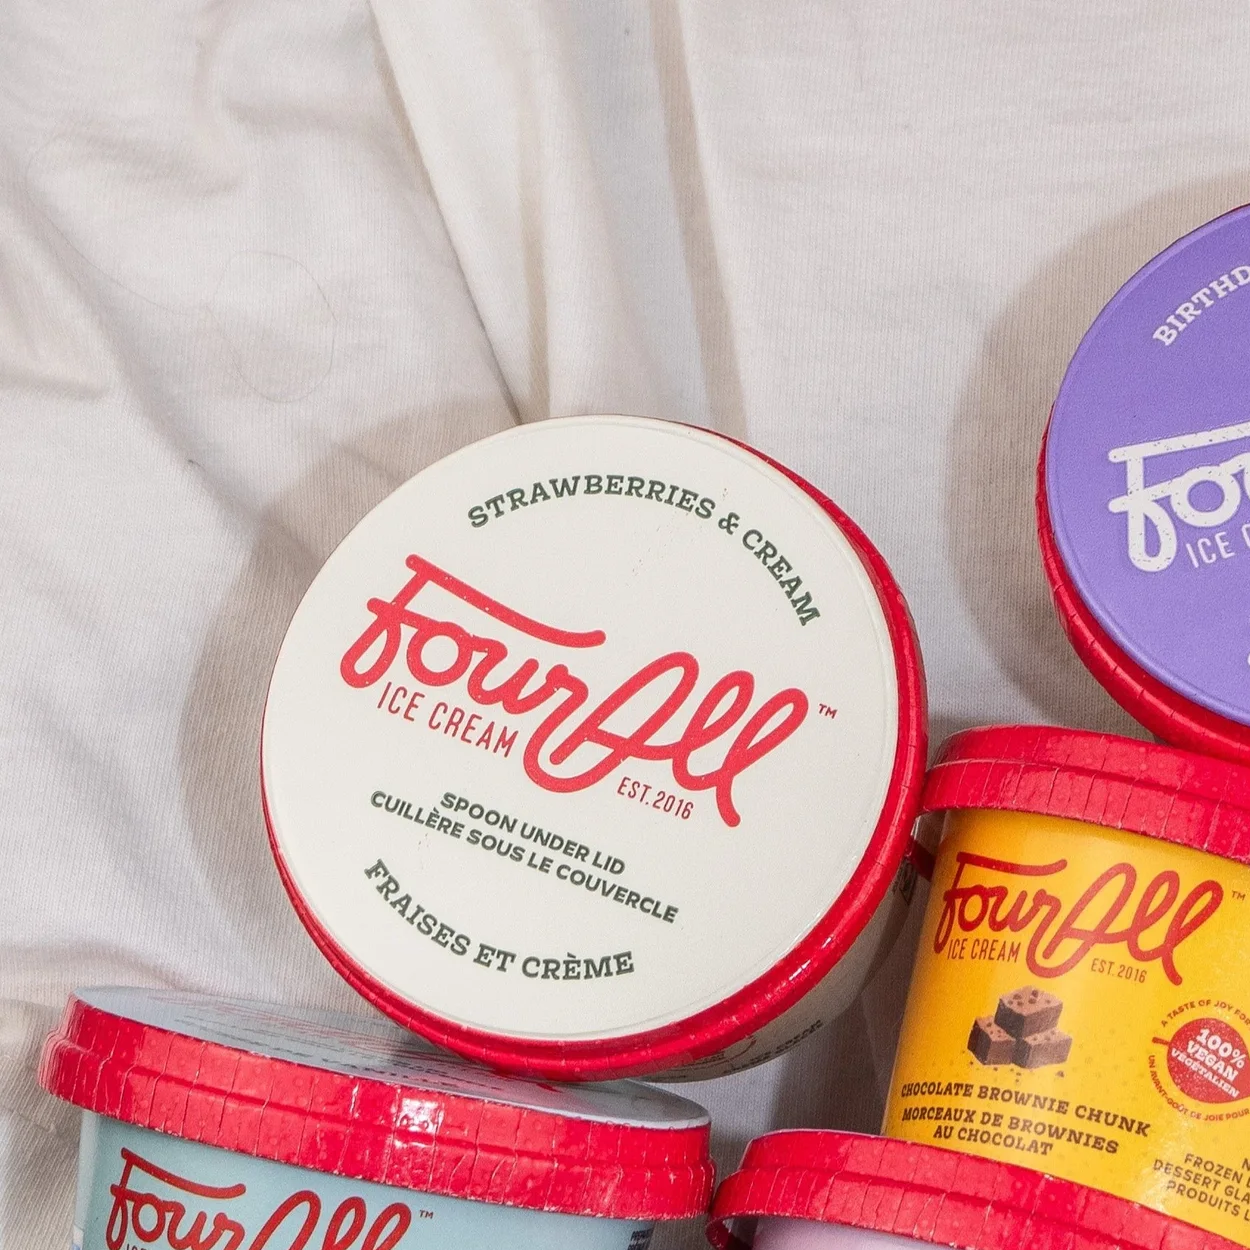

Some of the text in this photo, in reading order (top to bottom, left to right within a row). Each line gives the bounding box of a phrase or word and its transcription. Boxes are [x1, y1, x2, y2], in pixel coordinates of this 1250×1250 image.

[468, 475, 820, 626] STRAWBERRIES & CREAM
[1186, 538, 1235, 568] ICE
[377, 683, 520, 758] ICE CREAM
[440, 792, 625, 875] SPOON UNDER LID
[370, 790, 678, 923] CUILLÈRE SOUS LE COUVERCLE
[364, 859, 635, 980] FRAISES ET CRÈME
[947, 939, 1021, 963] ICE CREAM
[1186, 1040, 1238, 1081] VEGAN
[1196, 1028, 1247, 1069] 100%
[901, 1082, 1151, 1137] CHOCOLATE BROWNIE CHUNK
[902, 1107, 1119, 1154] MORCEAUX DE BROWNIES
[933, 1125, 1053, 1157] AU CHOCOLAT
[1153, 1159, 1220, 1194] DESSERT
[1183, 1152, 1243, 1186] FROZEN
[1166, 1180, 1241, 1217] PRODUITS
